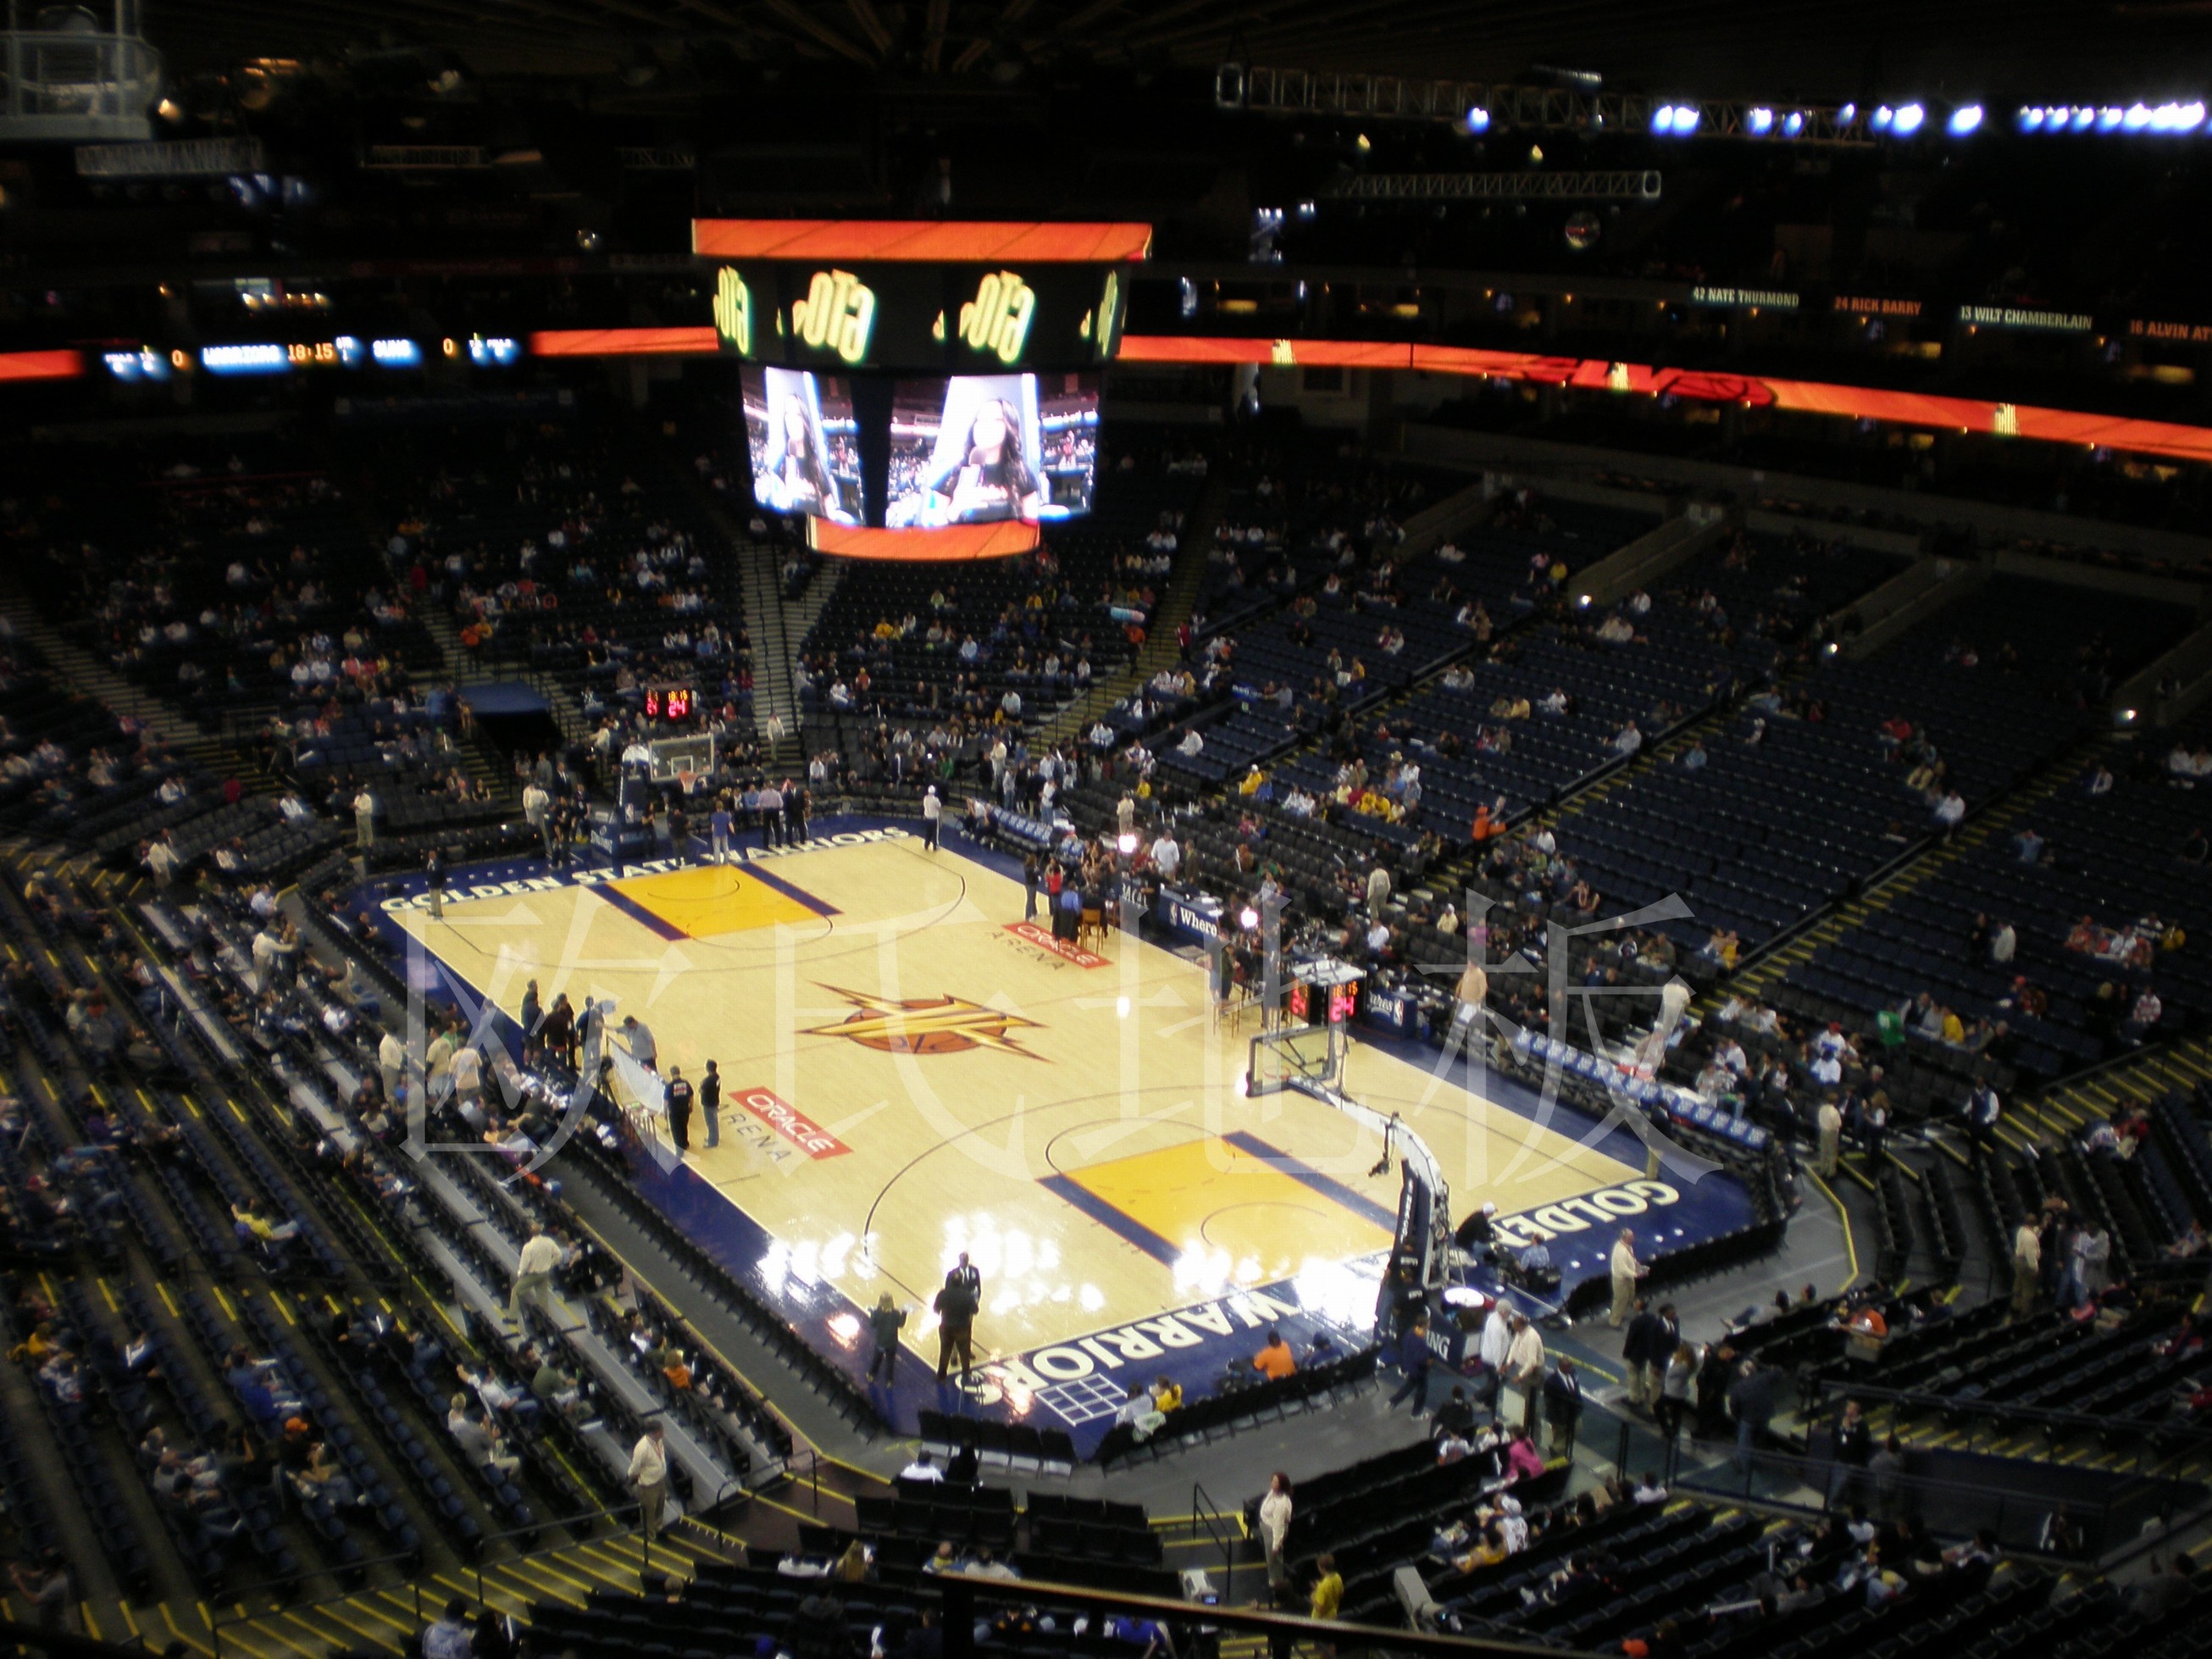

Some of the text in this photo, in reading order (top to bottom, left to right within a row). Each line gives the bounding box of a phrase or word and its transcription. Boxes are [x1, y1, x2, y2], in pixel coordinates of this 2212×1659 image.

[1708, 287, 1736, 303] NATE
[1738, 289, 1799, 308] THURMOND
[1851, 297, 1879, 313] RICK
[1882, 298, 1922, 316] BARRY
[1974, 306, 2003, 324] WILT
[2004, 308, 2093, 330] CHAMBERLAIN
[2147, 321, 2189, 339] ALVIN
[203, 344, 281, 366] WARRIORS
[287, 342, 335, 362] 18:15
[668, 699, 685, 717] 24
[380, 875, 563, 912] GOLDEN
[1329, 995, 1355, 1023] 24
[746, 1093, 836, 1153] ORACLE
